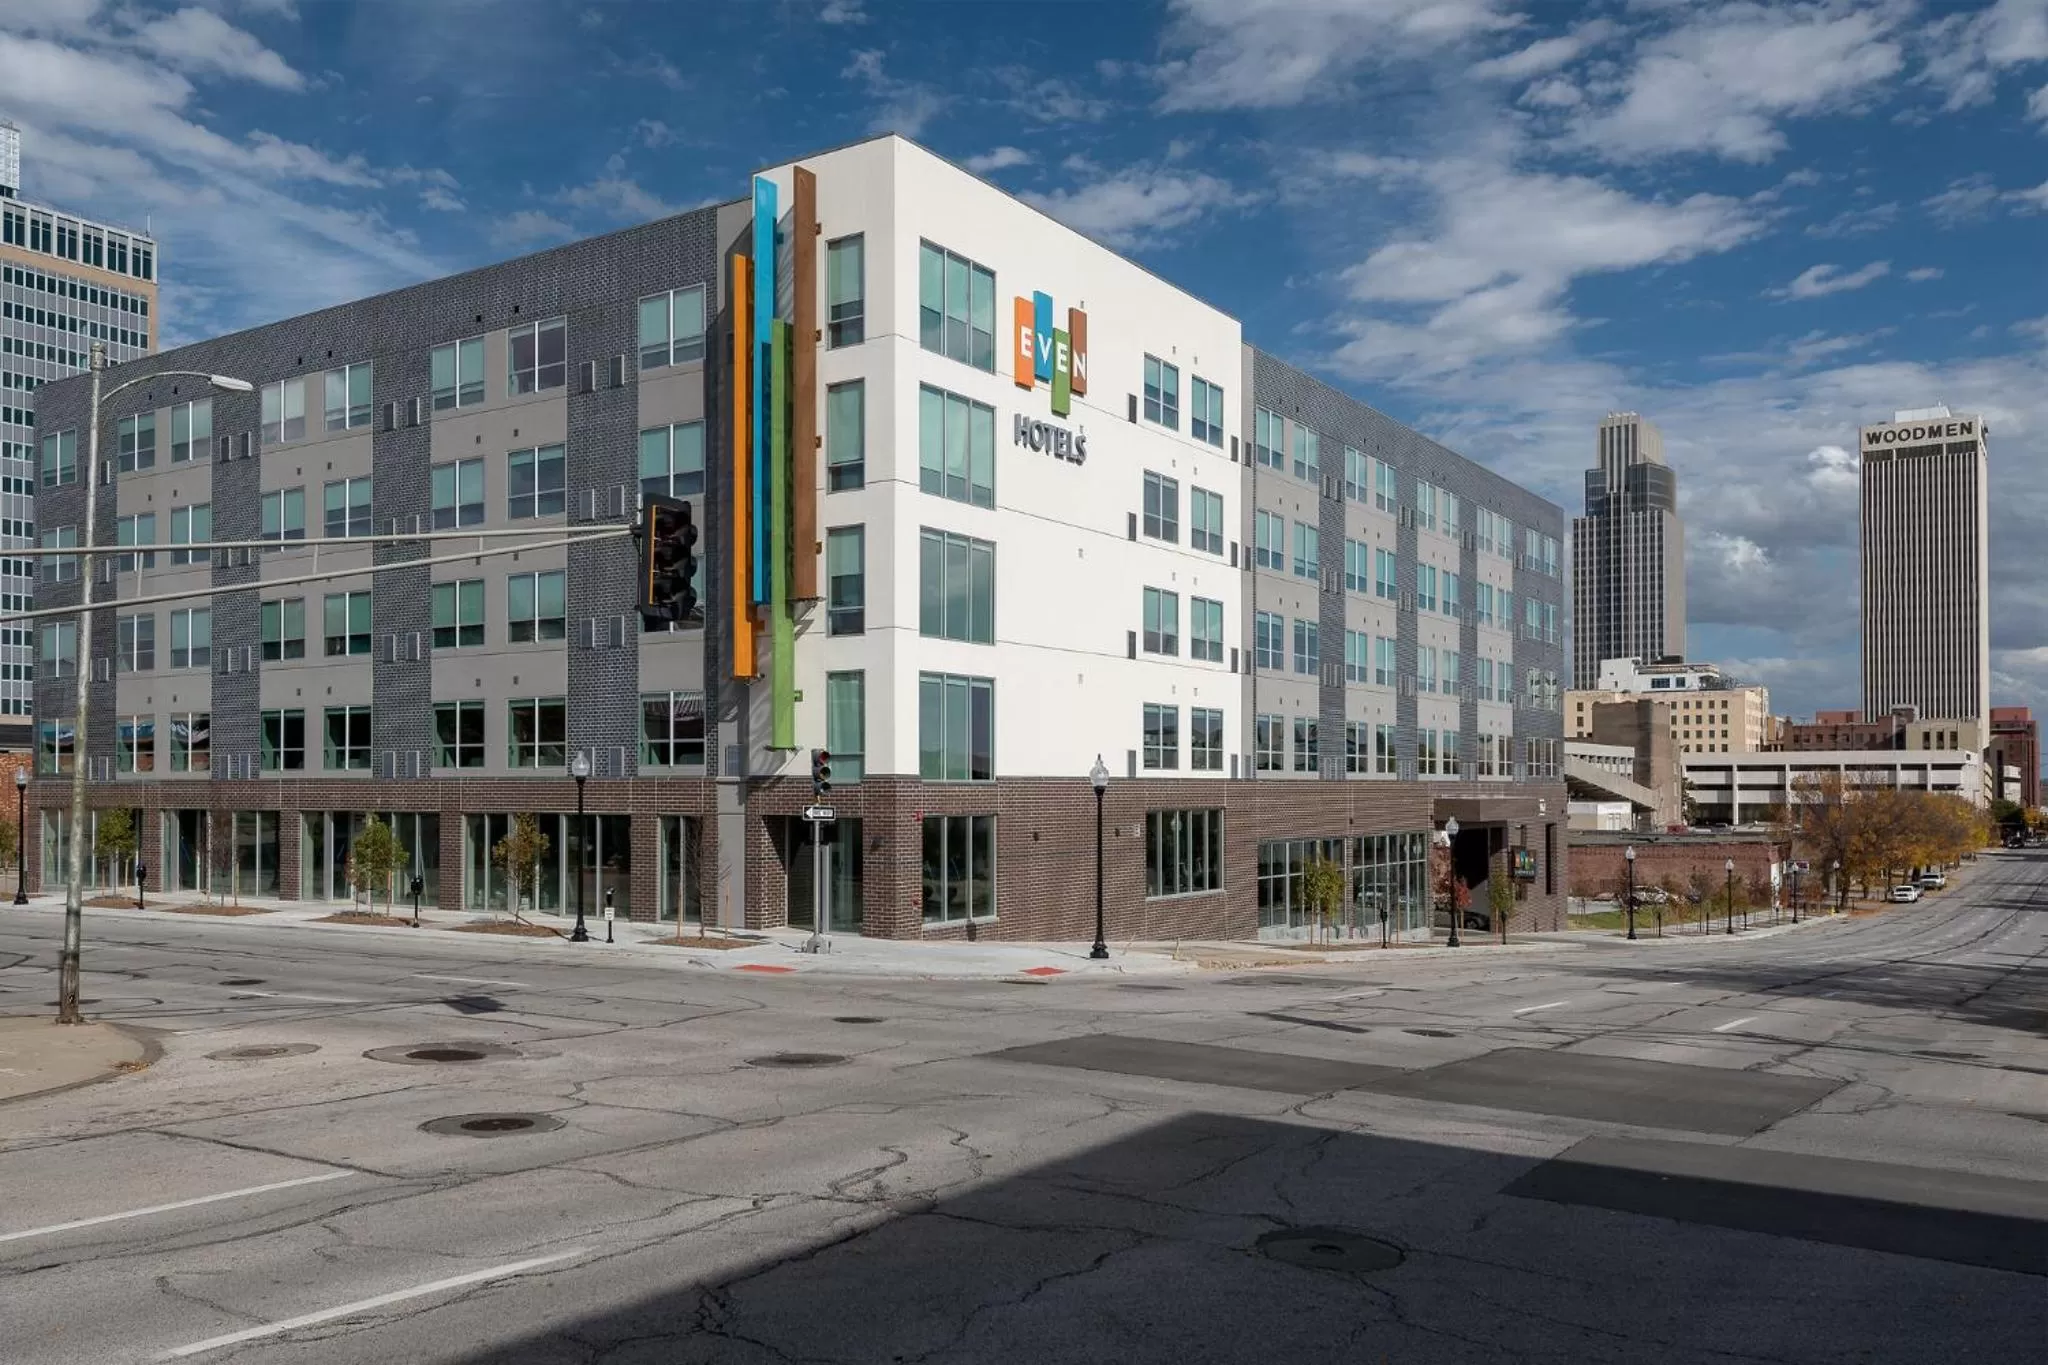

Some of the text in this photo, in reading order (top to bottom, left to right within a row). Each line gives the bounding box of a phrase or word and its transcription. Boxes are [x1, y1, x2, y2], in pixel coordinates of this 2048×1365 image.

[1020, 325, 1086, 380] EVEN
[1014, 413, 1087, 466] HOTELS
[1866, 421, 1973, 445] WOODMEN
